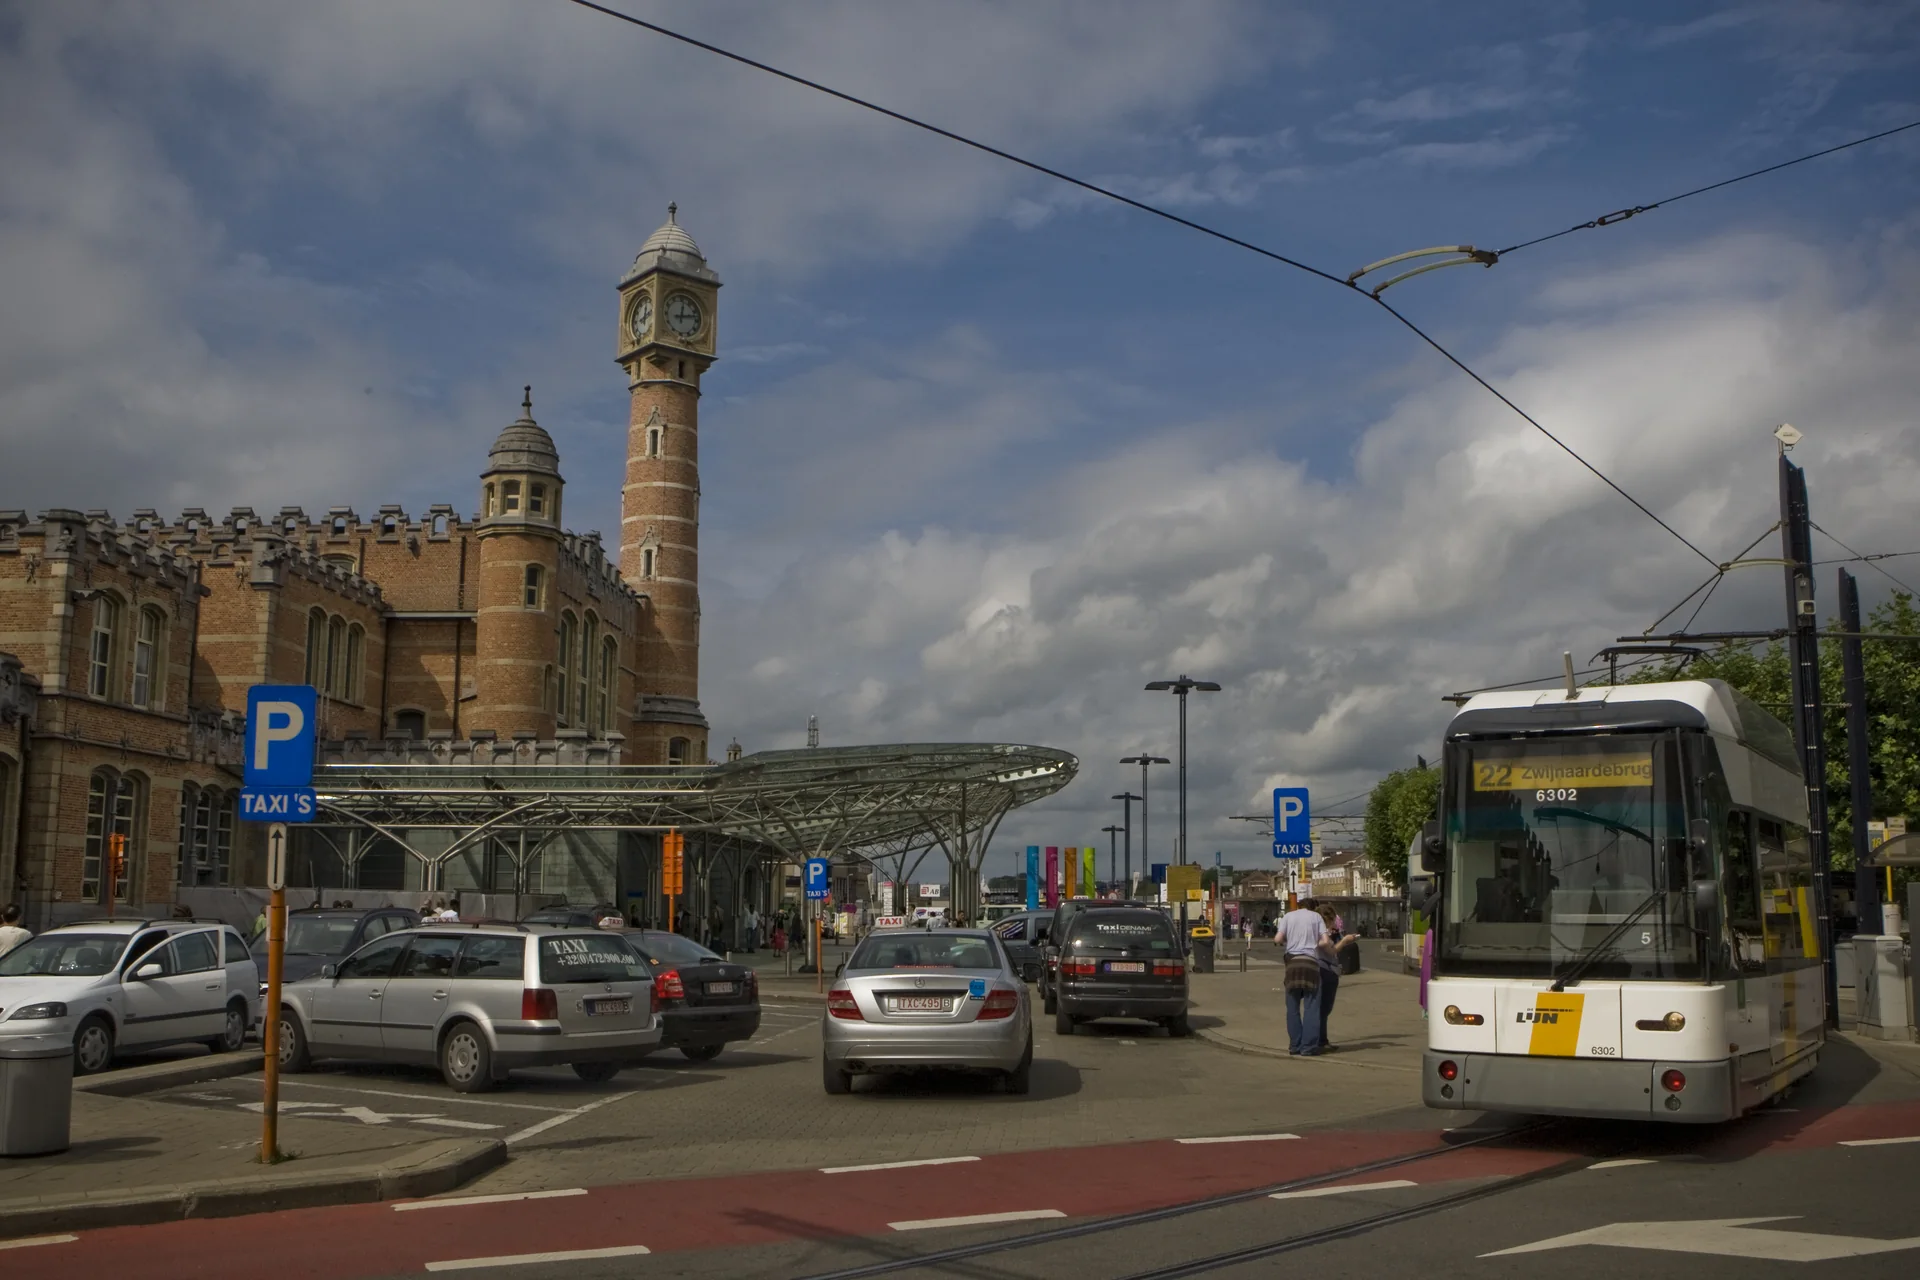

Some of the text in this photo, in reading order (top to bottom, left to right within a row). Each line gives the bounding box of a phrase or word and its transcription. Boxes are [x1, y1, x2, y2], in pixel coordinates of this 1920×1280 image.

[254, 701, 304, 770] P
[1479, 763, 1653, 787] 22 Zwijnaardebrug
[1536, 789, 1577, 802] 6302
[1279, 796, 1304, 832] P
[809, 863, 823, 884] P
[879, 918, 902, 926] TAXI
[1641, 932, 1650, 944] 5
[549, 939, 588, 954] TAXI
[944, 999, 950, 1008] B
[1591, 1047, 1615, 1056] 6302
